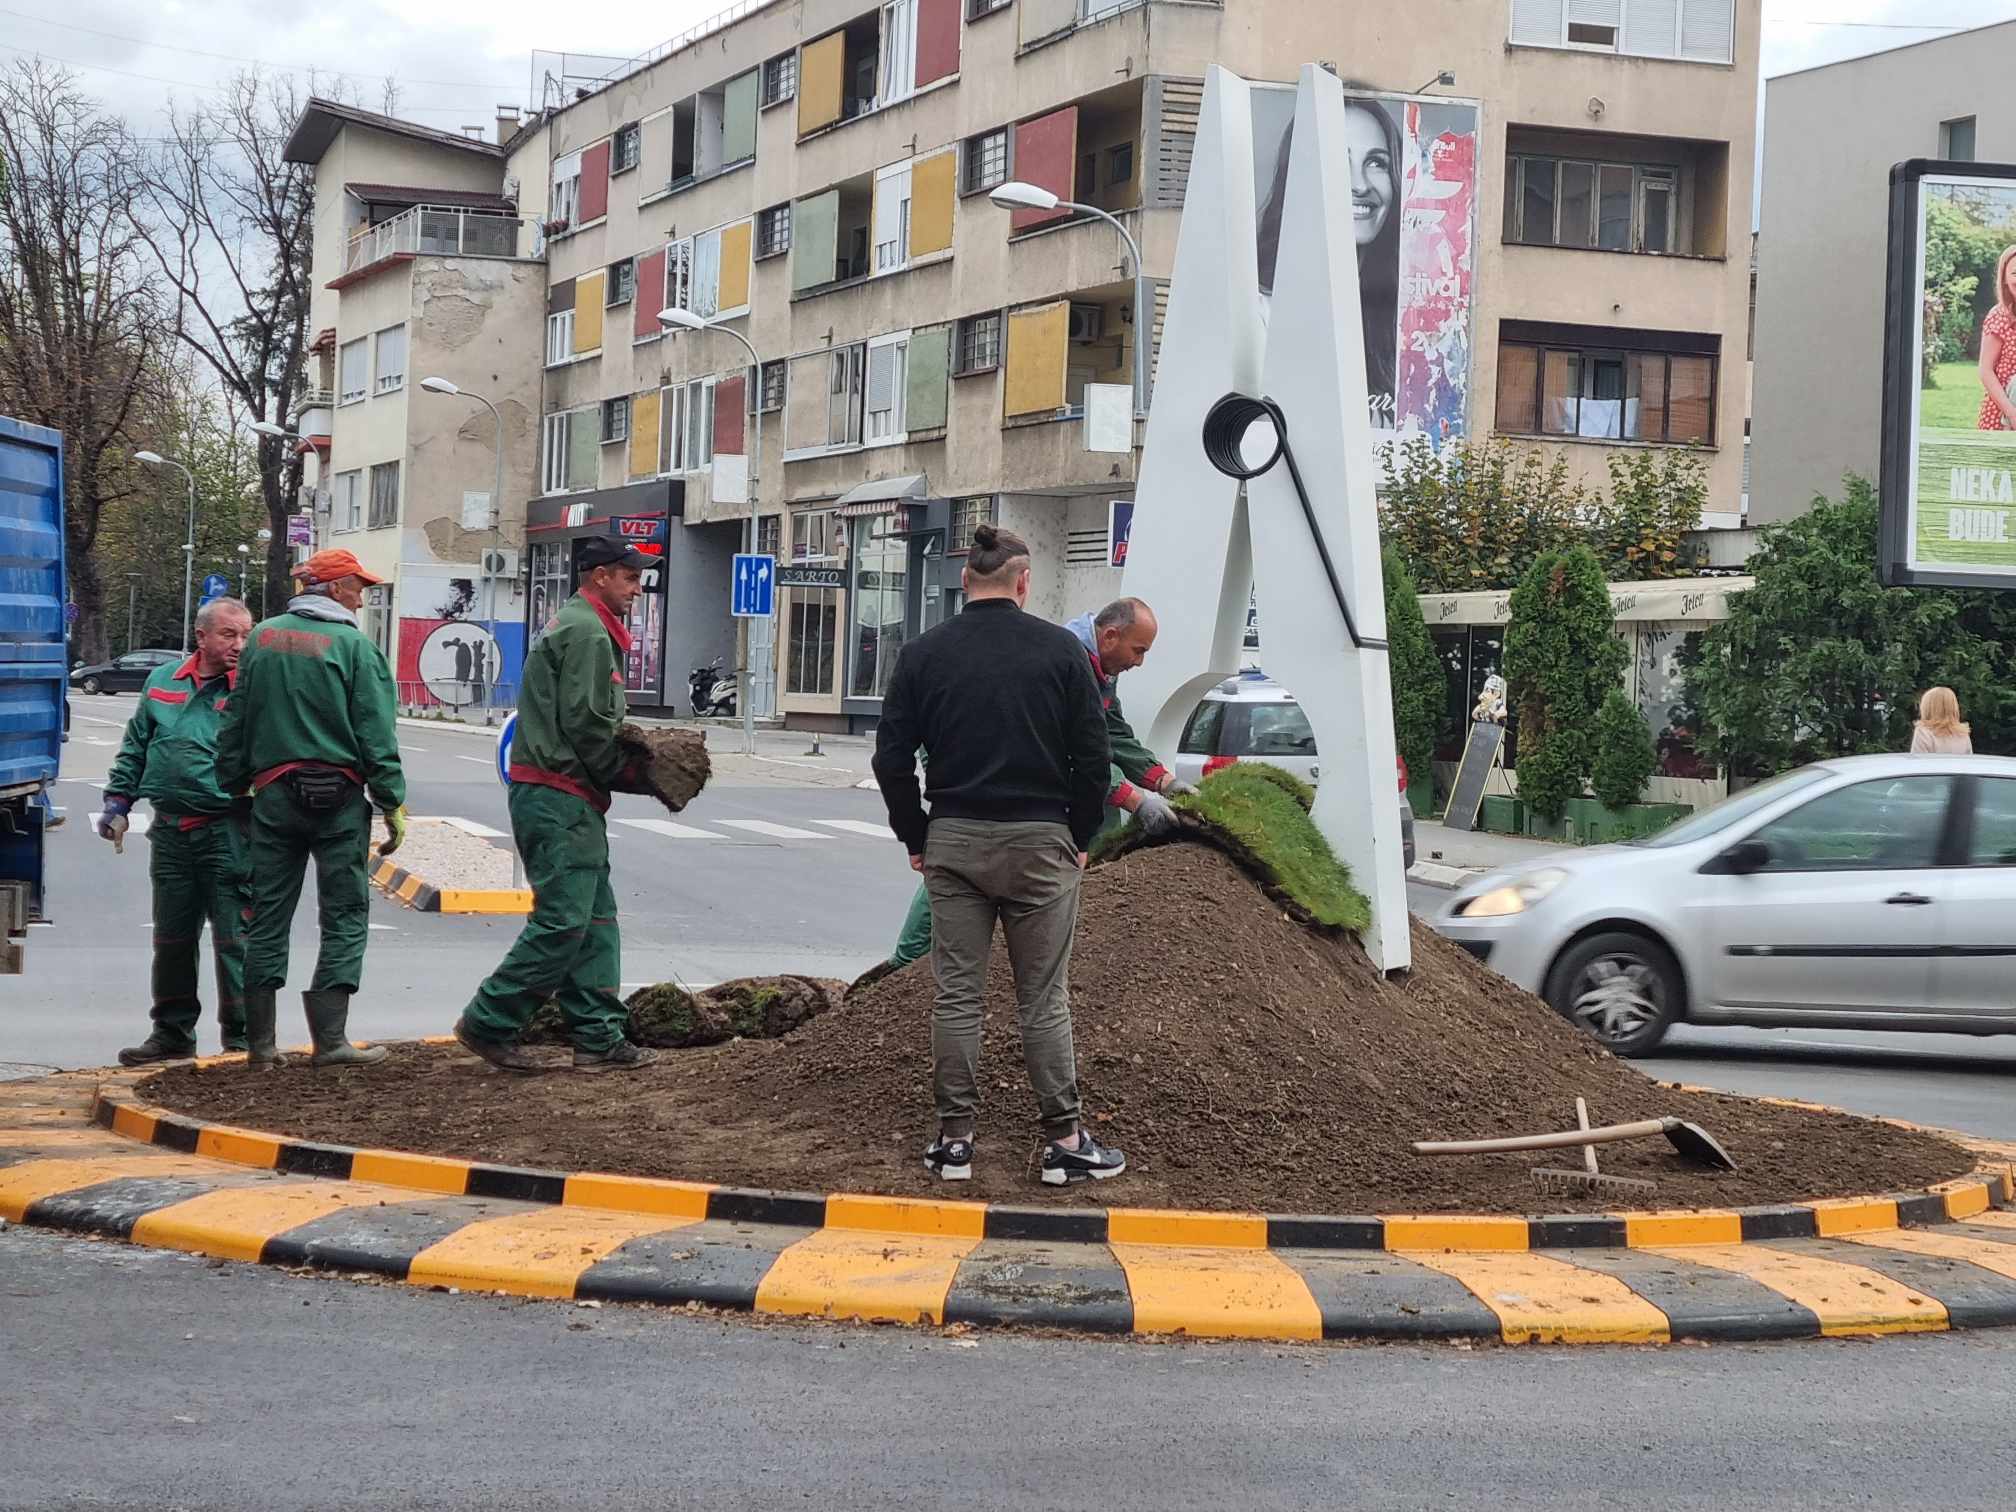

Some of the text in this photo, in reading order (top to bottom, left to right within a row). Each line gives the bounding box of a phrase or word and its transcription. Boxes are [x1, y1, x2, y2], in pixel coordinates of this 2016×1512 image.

[1950, 467, 2013, 502] NEKA
[619, 519, 659, 536] VLT
[783, 570, 840, 582] SARTO
[1494, 600, 1509, 620] Jele
[1681, 592, 1704, 616] Jelen
